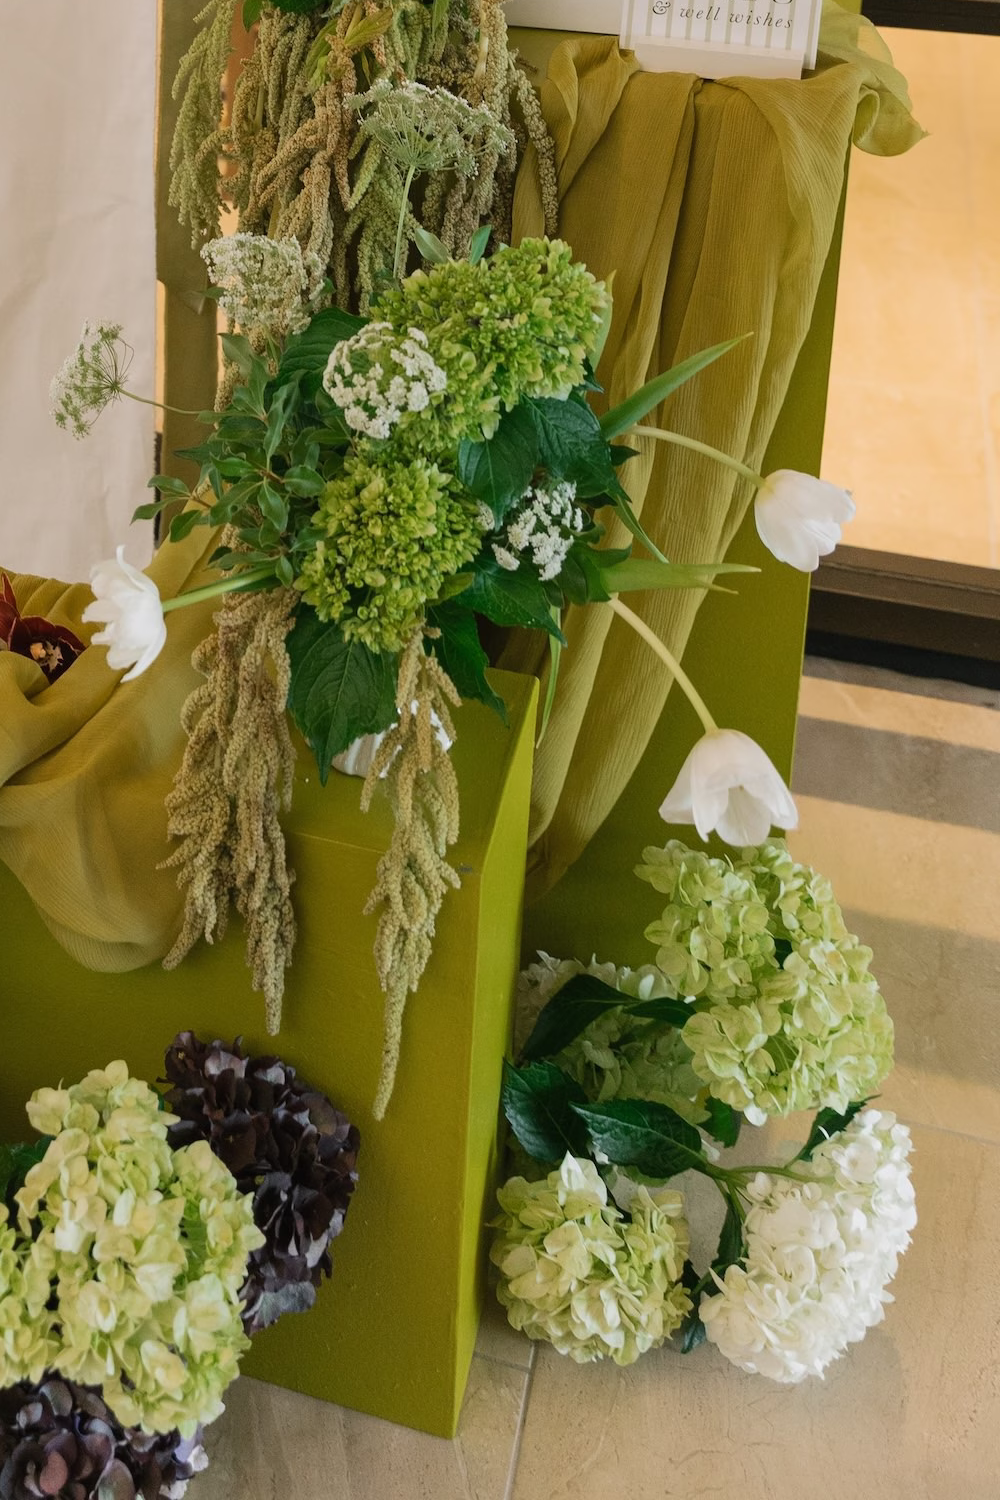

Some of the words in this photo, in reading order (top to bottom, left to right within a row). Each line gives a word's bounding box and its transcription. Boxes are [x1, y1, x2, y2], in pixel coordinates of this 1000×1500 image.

[651, 0, 671, 16] &
[680, 5, 721, 22] well
[729, 11, 795, 29] wishes
